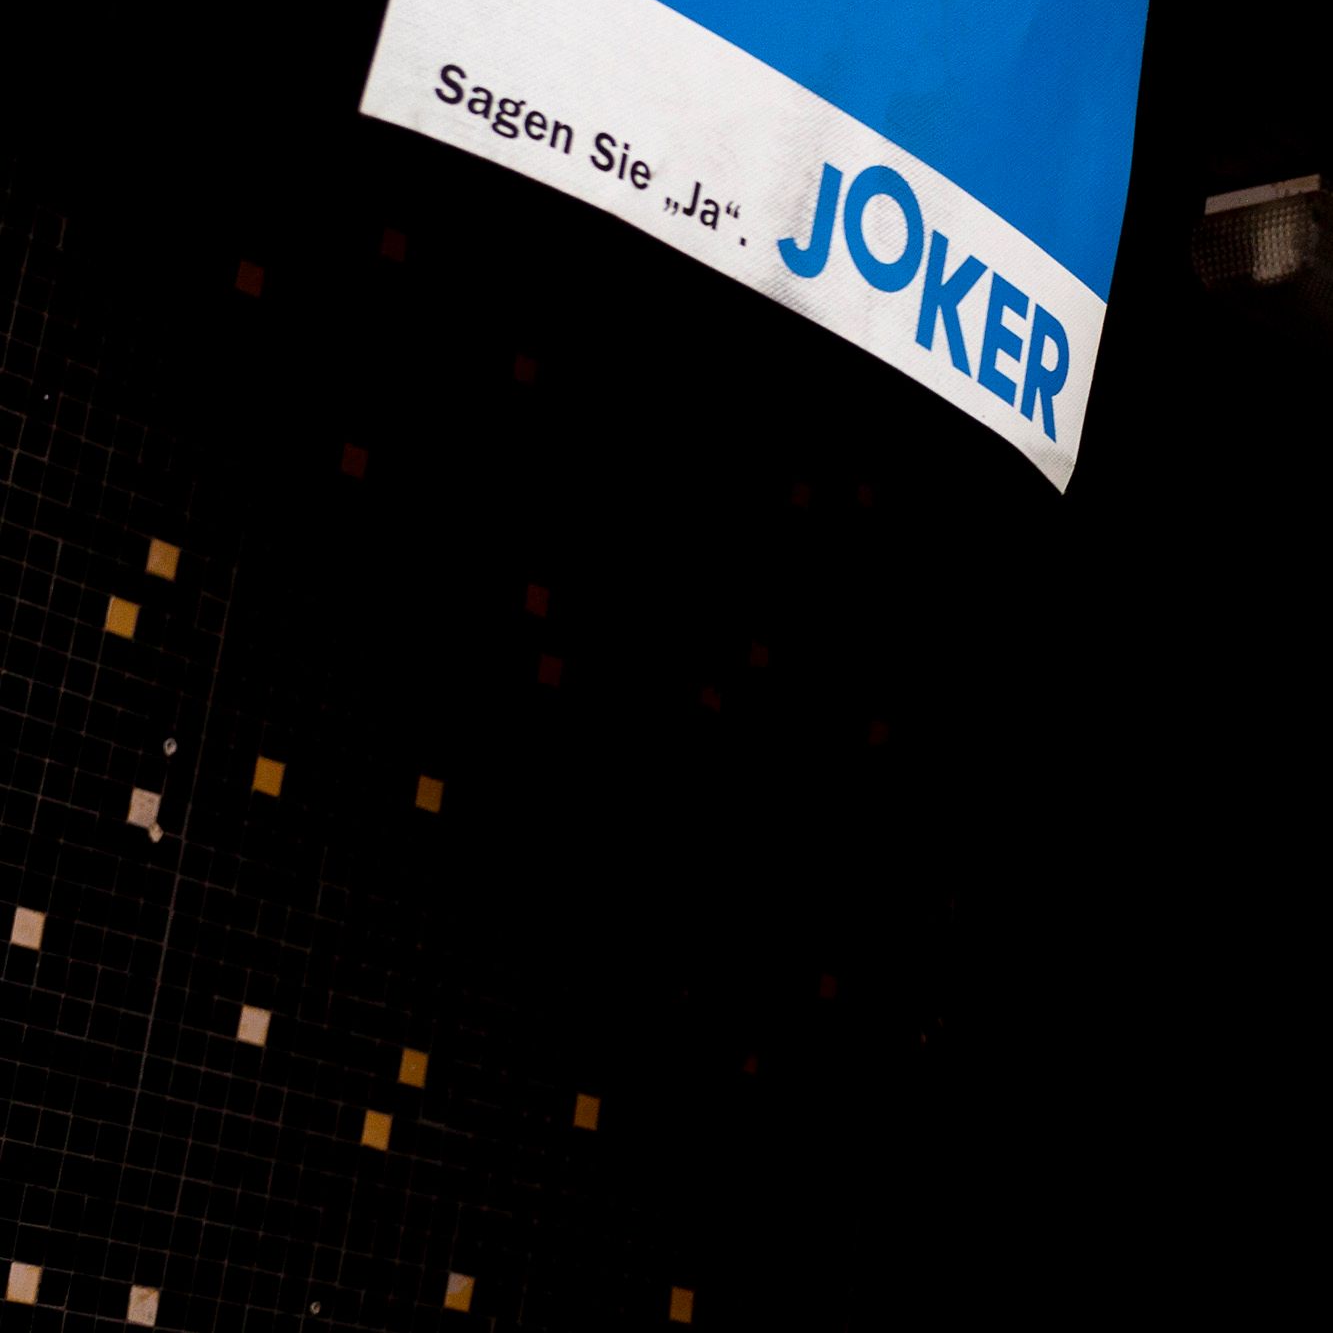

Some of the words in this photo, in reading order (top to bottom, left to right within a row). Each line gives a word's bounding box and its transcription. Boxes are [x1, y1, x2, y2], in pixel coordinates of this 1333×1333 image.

[435, 64, 573, 154] Sagen
[590, 132, 652, 190] Sie
[777, 163, 1069, 443] JOKER
